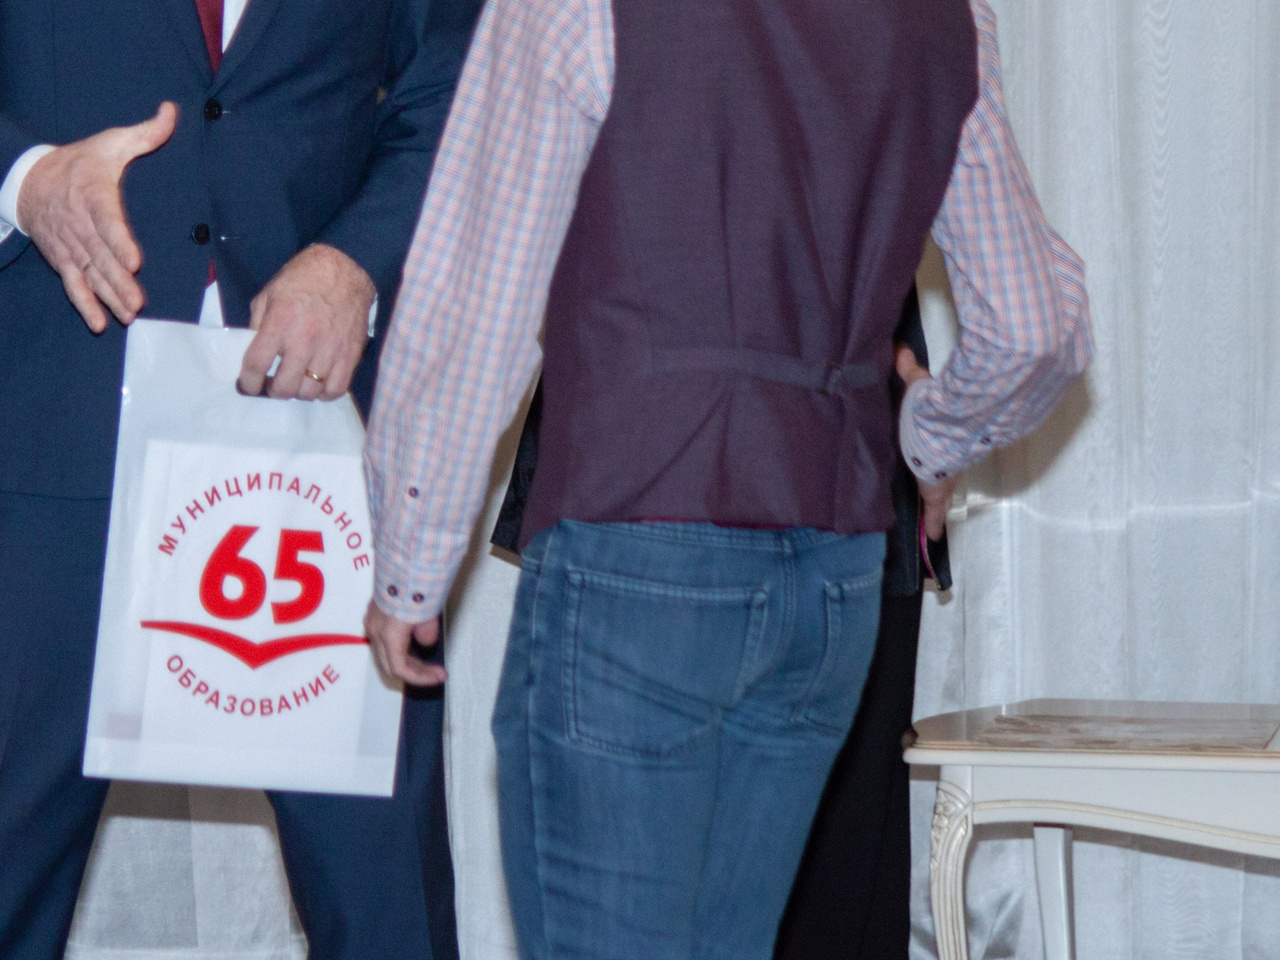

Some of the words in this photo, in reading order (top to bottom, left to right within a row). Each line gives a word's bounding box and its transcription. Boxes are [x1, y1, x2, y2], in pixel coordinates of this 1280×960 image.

[158, 472, 370, 571] МУНИЦИПАЛЬНОЕ
[199, 524, 325, 625] 65
[166, 654, 340, 717] ОБРАЗОВАНИЕ
